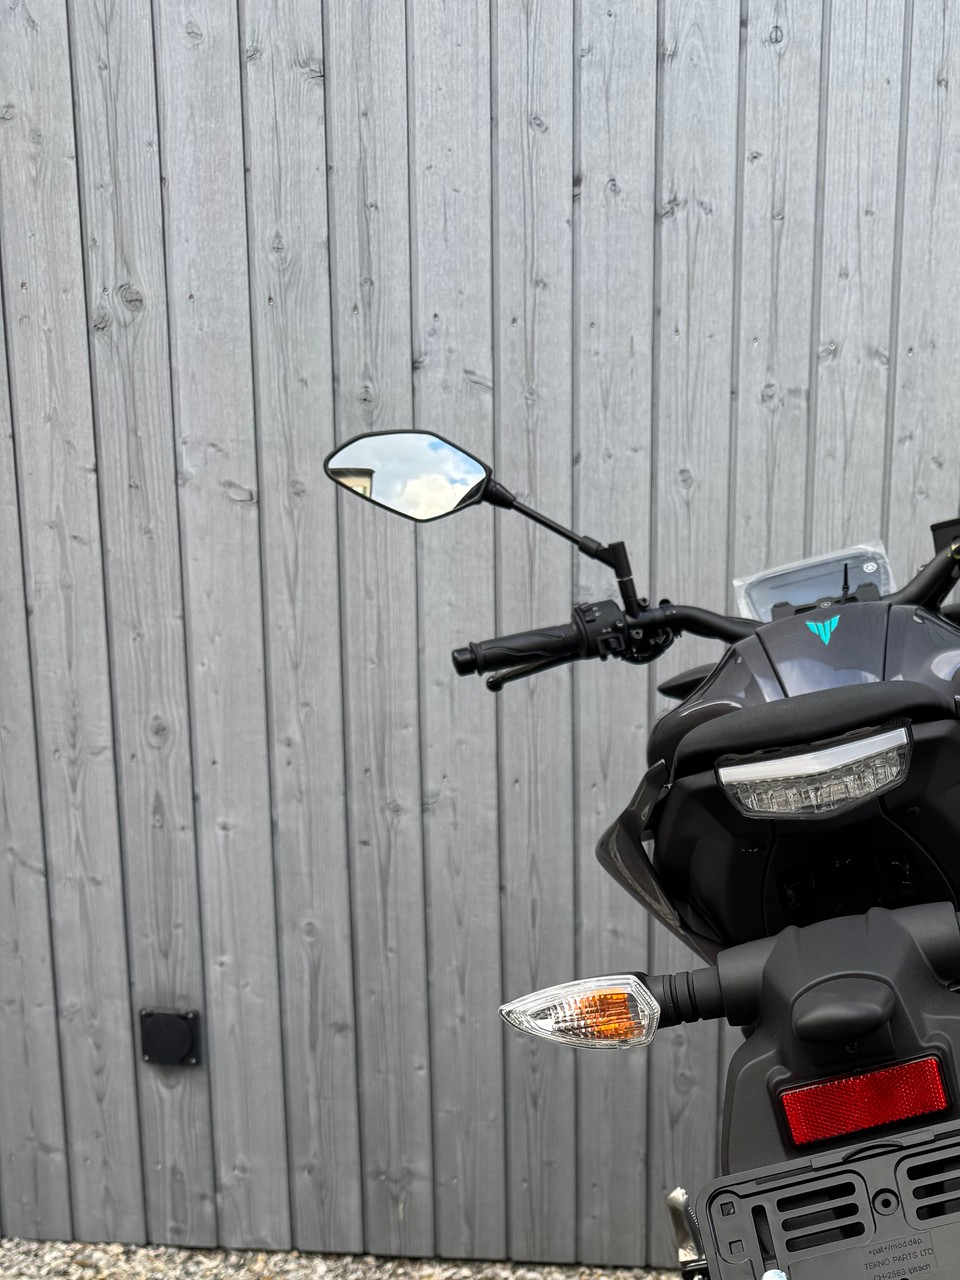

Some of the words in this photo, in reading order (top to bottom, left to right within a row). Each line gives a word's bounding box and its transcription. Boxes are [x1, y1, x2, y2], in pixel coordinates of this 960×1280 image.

[864, 1258, 890, 1270] TEKNO
[892, 1252, 918, 1263] PARTS
[920, 1248, 933, 1257] LTD
